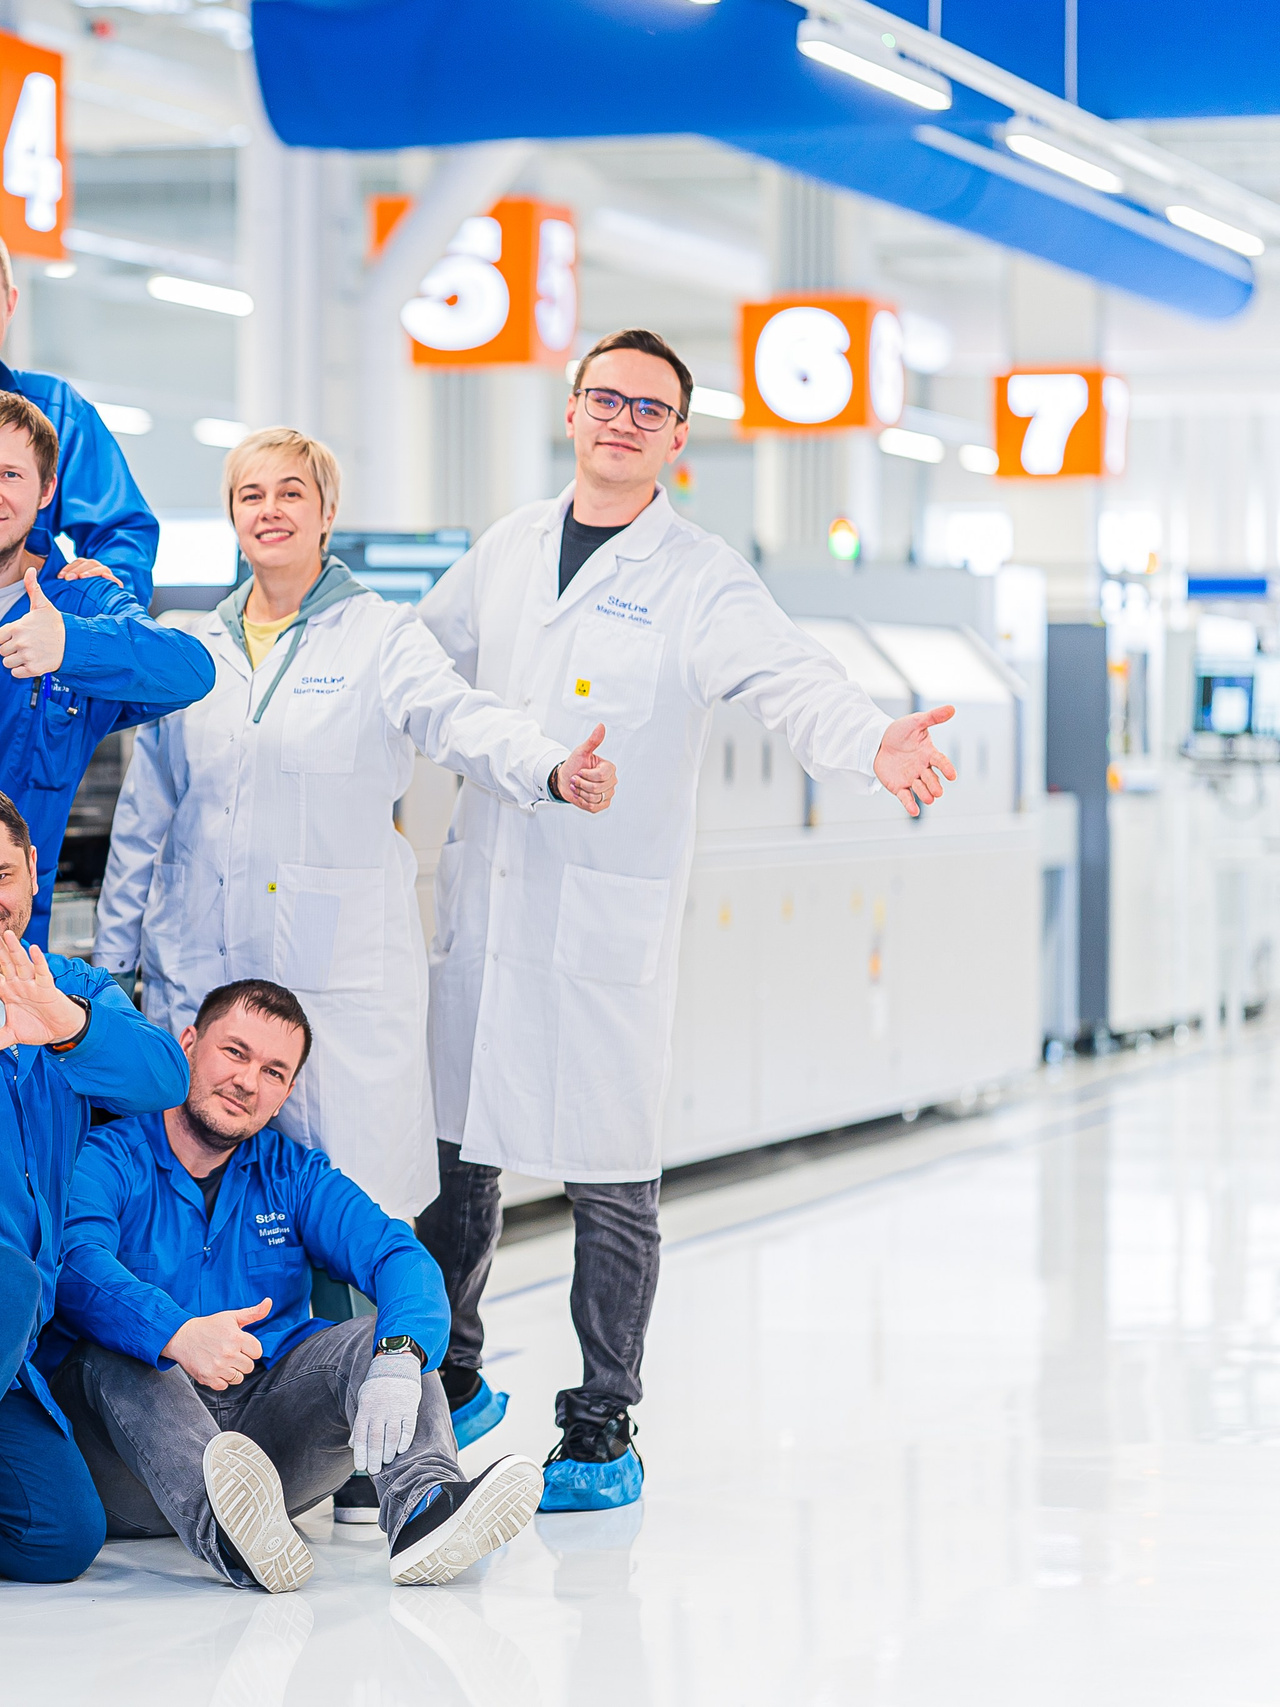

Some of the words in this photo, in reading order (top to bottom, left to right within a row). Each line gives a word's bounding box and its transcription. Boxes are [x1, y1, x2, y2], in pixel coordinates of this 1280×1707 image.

[3, 72, 62, 232] 4
[399, 216, 510, 351] 5
[755, 306, 853, 424] 6
[1007, 373, 1089, 476] 7
